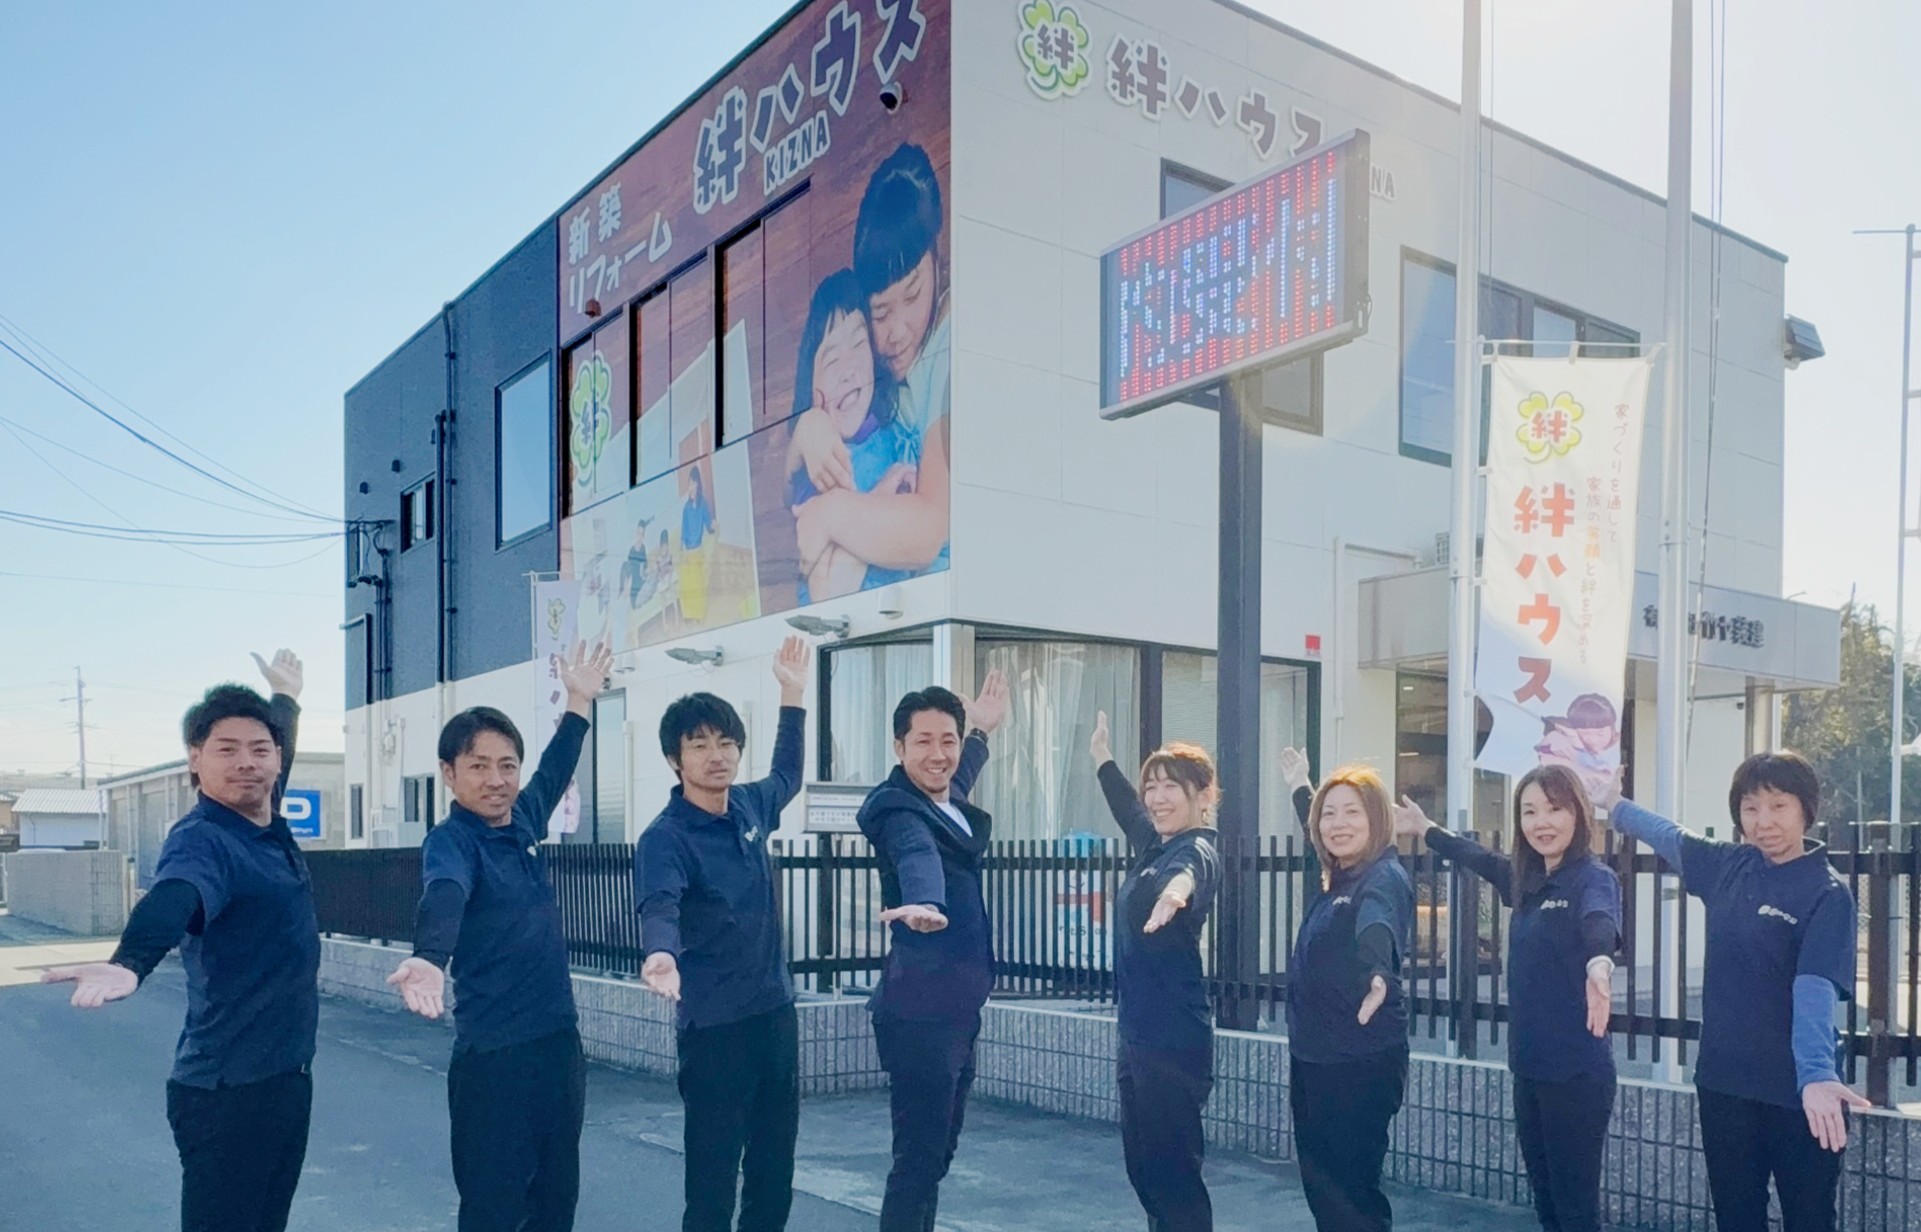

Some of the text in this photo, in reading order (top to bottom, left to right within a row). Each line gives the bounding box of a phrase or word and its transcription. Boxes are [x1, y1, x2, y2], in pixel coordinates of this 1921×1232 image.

[1037, 23, 1076, 71] 絆
[694, 0, 926, 215] 絆ハウス
[764, 110, 831, 195] KIZNA
[1370, 162, 1397, 200] NA
[569, 183, 622, 265] 新築
[569, 211, 673, 315] リフォーム
[1530, 410, 1568, 443] 絆
[1606, 403, 1629, 543] 家づくりを通して
[1513, 481, 1576, 704] 絆ハウス
